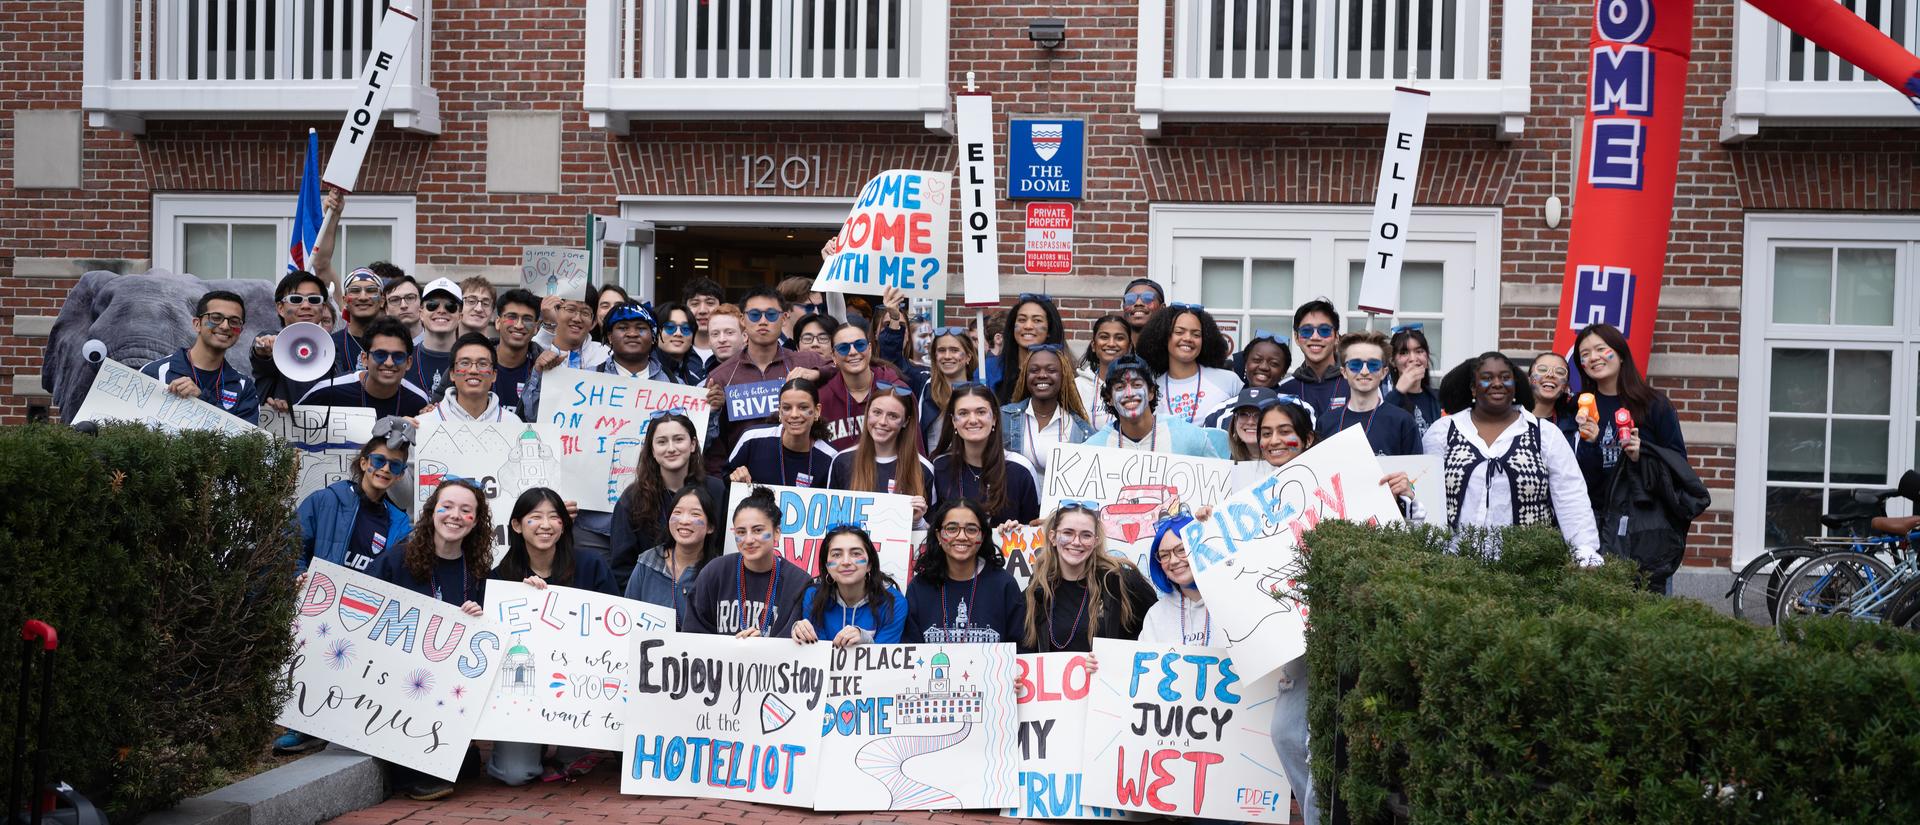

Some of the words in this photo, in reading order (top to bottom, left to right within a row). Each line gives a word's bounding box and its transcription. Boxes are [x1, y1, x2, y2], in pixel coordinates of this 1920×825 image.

[350, 51, 393, 144] ELIOT
[742, 155, 820, 190] 1201
[1029, 165, 1063, 178] THE
[858, 174, 922, 210] COME
[968, 143, 988, 253] ELIOT
[1021, 179, 1071, 192] DOME
[1033, 208, 1066, 218] PRIVATE
[1378, 132, 1412, 269] ELIOT
[836, 212, 933, 254] DOME
[1029, 218, 1070, 228] PROPERTY
[1042, 230, 1057, 240] NO
[525, 249, 556, 262] gimme
[562, 251, 585, 260] some
[1027, 240, 1071, 250] TRESPASSING
[1028, 253, 1056, 261] VIOLATORS
[1057, 253, 1070, 261] WILL
[521, 257, 587, 289] DOME
[879, 255, 940, 290] ME?
[1027, 260, 1035, 268] BE
[1036, 260, 1070, 269] PROSECUTED
[573, 381, 628, 408] SHE
[729, 388, 741, 399] life
[743, 389, 749, 398] is
[751, 386, 769, 396] better
[732, 394, 779, 417] RIVE
[554, 411, 584, 430] ON
[827, 415, 865, 443] HARV
[1049, 448, 1233, 505] KA-CHOW
[780, 490, 875, 537] DOME
[1186, 476, 1297, 574] RIDE
[551, 649, 569, 666] is
[854, 646, 917, 671] PLACE
[362, 660, 389, 685] is
[638, 639, 724, 707] Enjoy
[729, 660, 778, 716] your
[777, 659, 824, 712] stay
[1016, 655, 1091, 705] BLO
[828, 676, 863, 697] IKE
[283, 654, 449, 754] homus
[541, 705, 593, 730] want
[601, 709, 625, 732] to
[696, 711, 712, 732] at
[718, 715, 741, 733] the
[1131, 702, 1234, 742] JUICY
[1157, 738, 1191, 748] and
[632, 733, 807, 795] HOTELIOT
[1116, 745, 1225, 816] WET
[1237, 787, 1280, 812] FDDE!
